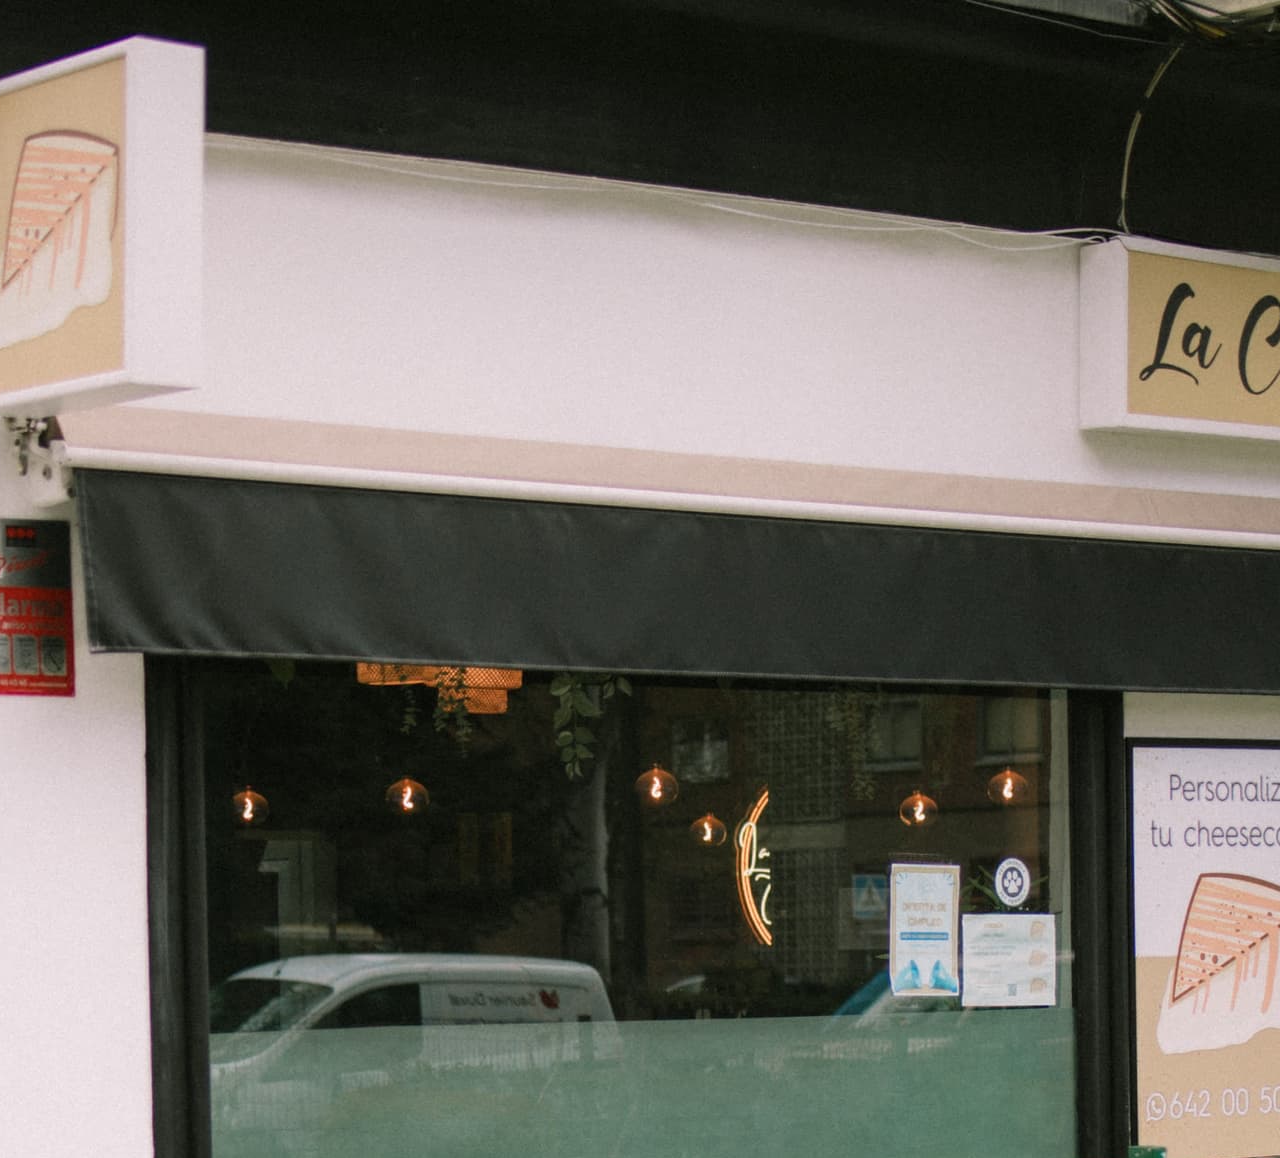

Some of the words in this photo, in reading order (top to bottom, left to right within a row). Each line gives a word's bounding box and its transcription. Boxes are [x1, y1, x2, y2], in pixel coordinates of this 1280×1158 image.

[1139, 283, 1221, 385] La
[1151, 820, 1173, 847] tu
[1170, 1090, 1211, 1119] 642
[1222, 1088, 1249, 1116] 00
